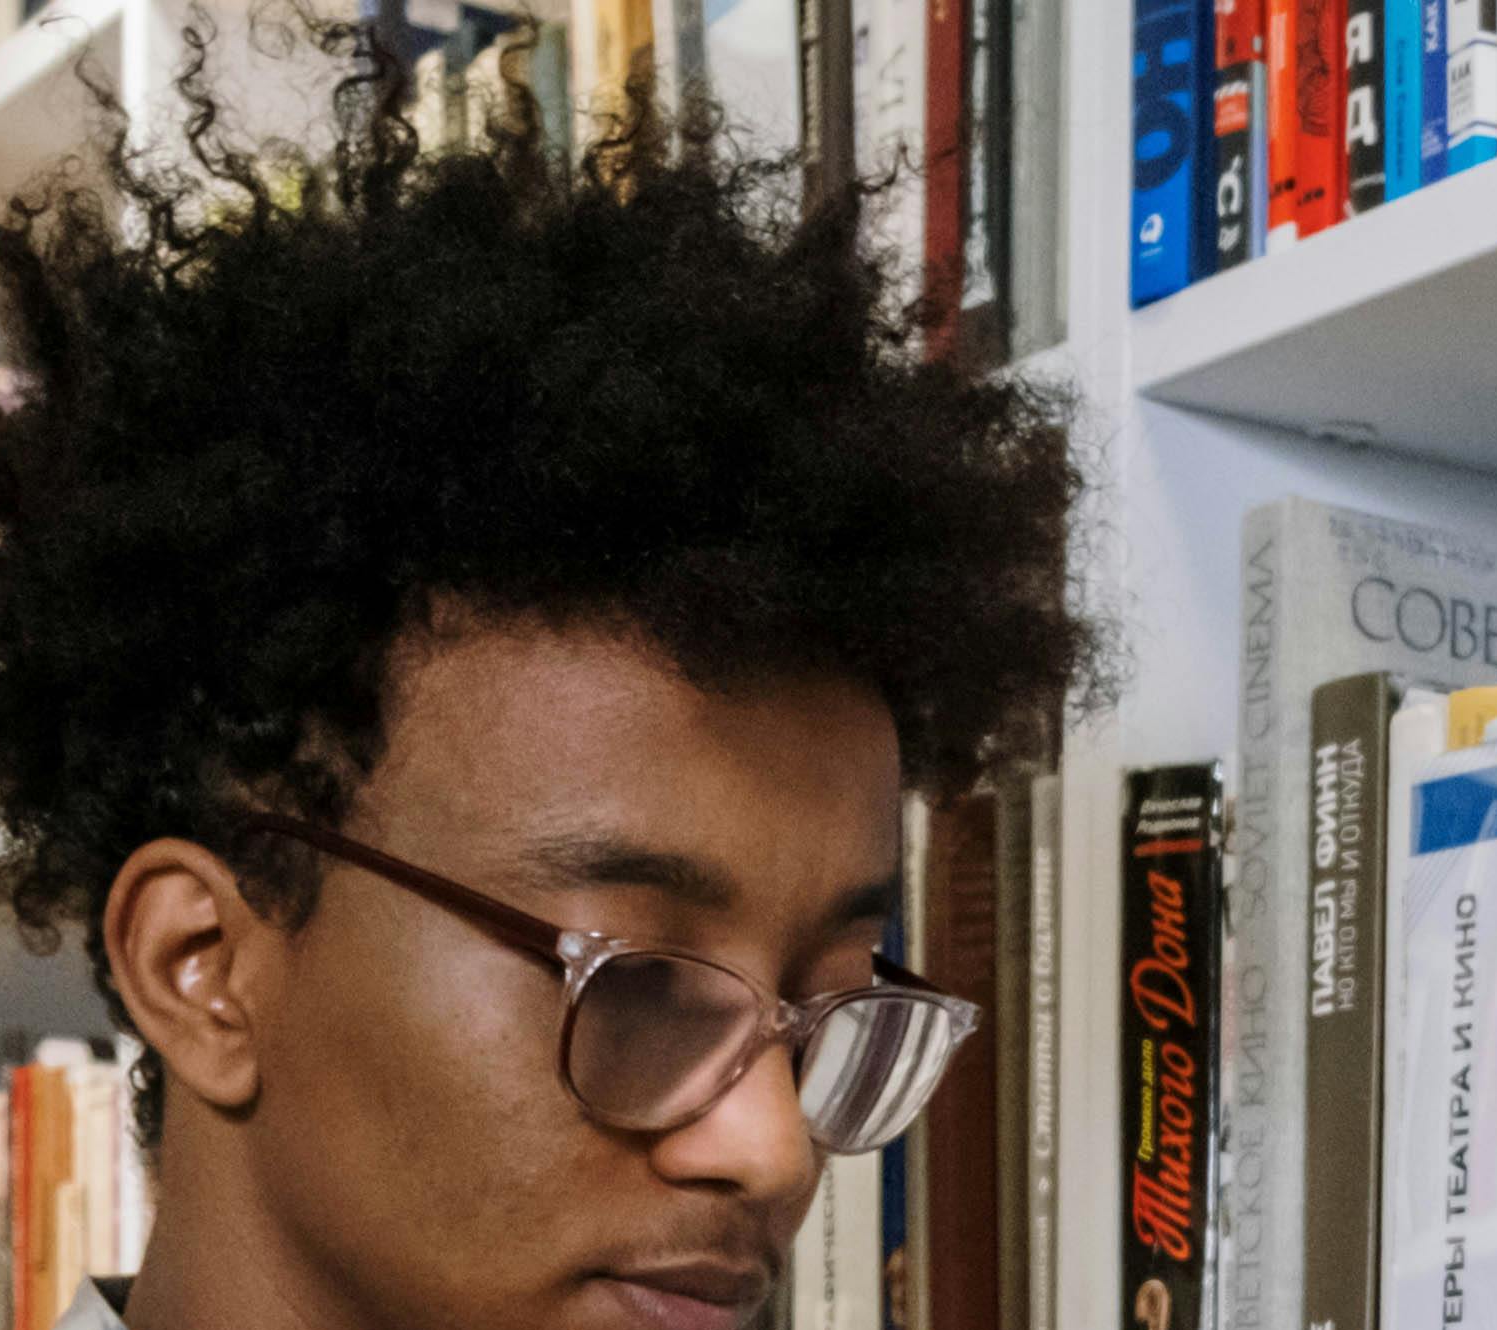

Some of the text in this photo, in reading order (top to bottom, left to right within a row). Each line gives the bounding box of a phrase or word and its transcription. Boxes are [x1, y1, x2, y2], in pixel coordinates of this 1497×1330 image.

[1131, 871, 1197, 1030] Дона
[1312, 743, 1339, 1017] ПАВЕЛ ФИНН
[1337, 739, 1363, 1011] НО КТО МЫ И ОТКУДА
[1453, 893, 1477, 1011] КИНО
[1452, 1028, 1472, 1051] И
[1133, 1043, 1195, 1261] Тихого
[1445, 1065, 1472, 1222] ТЕАТРА
